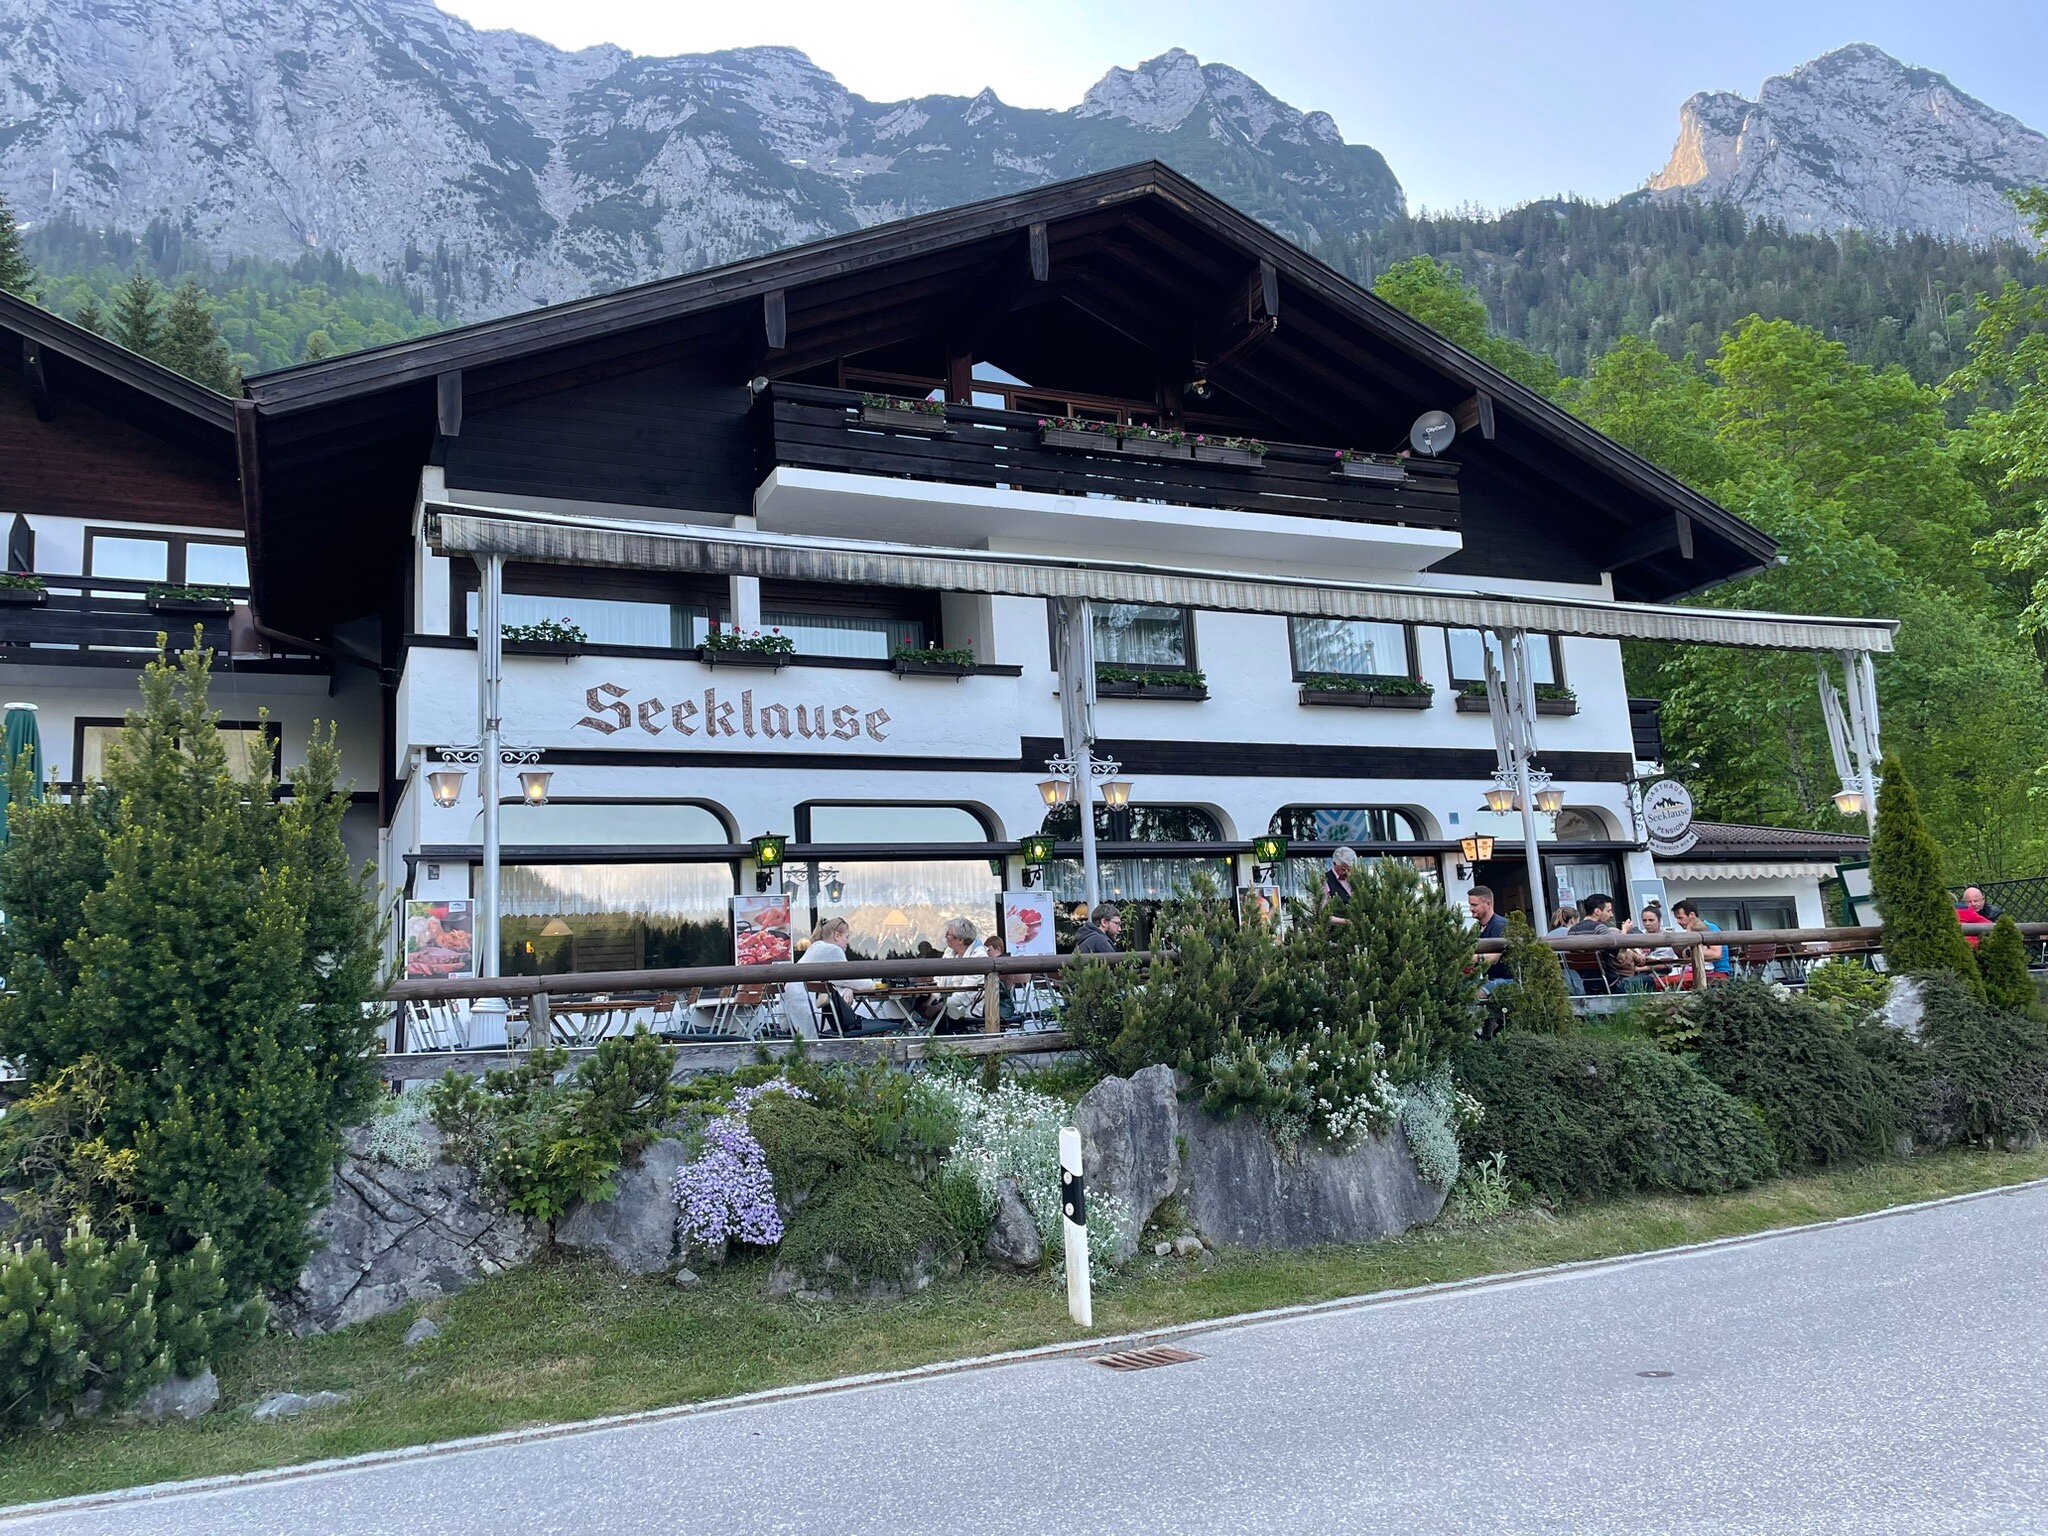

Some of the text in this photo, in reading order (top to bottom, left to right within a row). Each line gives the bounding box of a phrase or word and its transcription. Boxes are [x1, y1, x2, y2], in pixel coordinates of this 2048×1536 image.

[570, 682, 892, 743] Seeklause
[1647, 783, 1684, 802] GASTHAUS
[1647, 807, 1690, 823] Seeklause
[1656, 822, 1685, 834] PENSION
